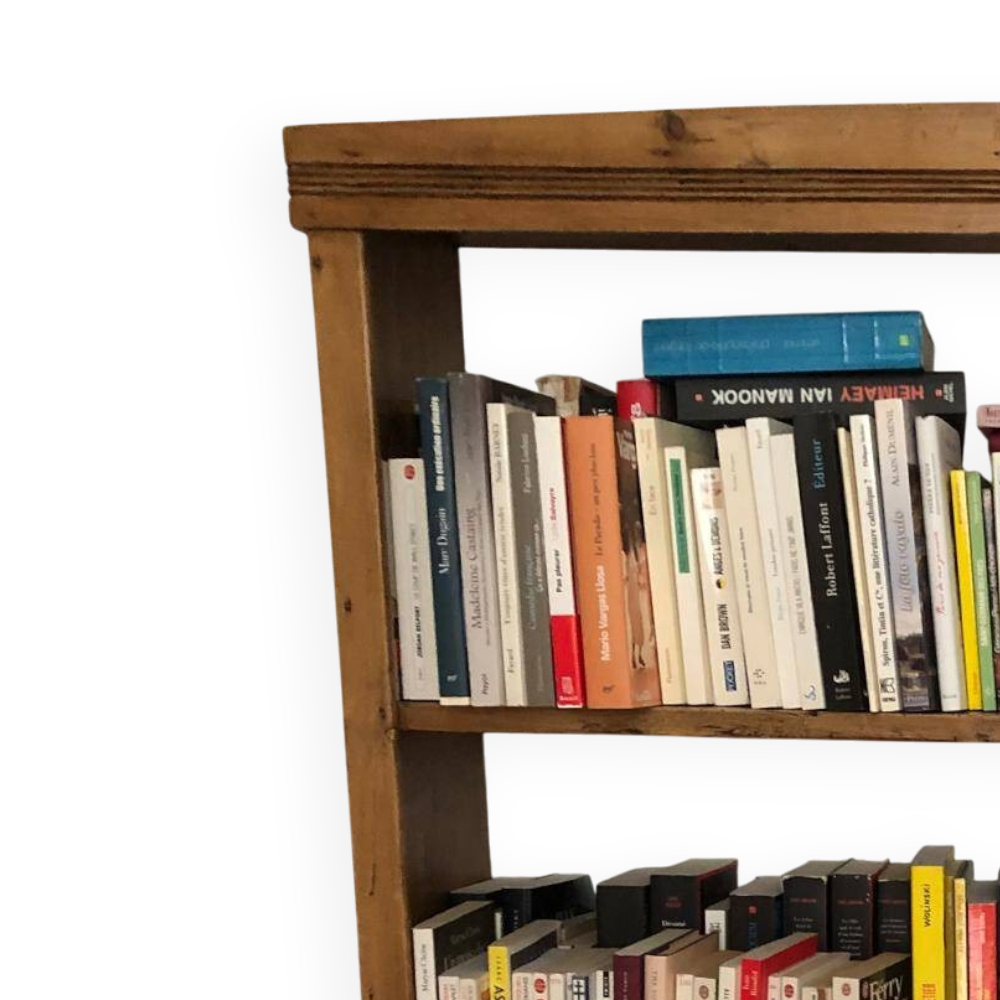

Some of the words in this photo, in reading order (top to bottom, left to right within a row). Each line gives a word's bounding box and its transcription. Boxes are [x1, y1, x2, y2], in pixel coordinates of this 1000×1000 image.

[711, 388, 794, 405] MANOOK
[800, 388, 832, 403] IAN
[840, 385, 924, 402] HEIMAEY
[430, 395, 441, 434] ordinaire
[811, 440, 826, 488] Éditeur
[866, 487, 877, 527] catholique
[464, 508, 478, 561] Castaing
[818, 502, 833, 549] Laffont
[552, 549, 562, 578] pleurer
[870, 529, 881, 569] littérature
[555, 580, 563, 593] Pas
[595, 566, 606, 592] Llosa
[825, 553, 838, 596] Robert
[874, 571, 883, 585] une
[467, 565, 483, 630] Madeleine
[597, 594, 610, 630] Vargas
[718, 603, 729, 631] BROWN
[878, 611, 887, 635] Tintin
[600, 632, 611, 660] Mario
[721, 634, 731, 649] DAN
[921, 884, 931, 927] WOLINSKI
